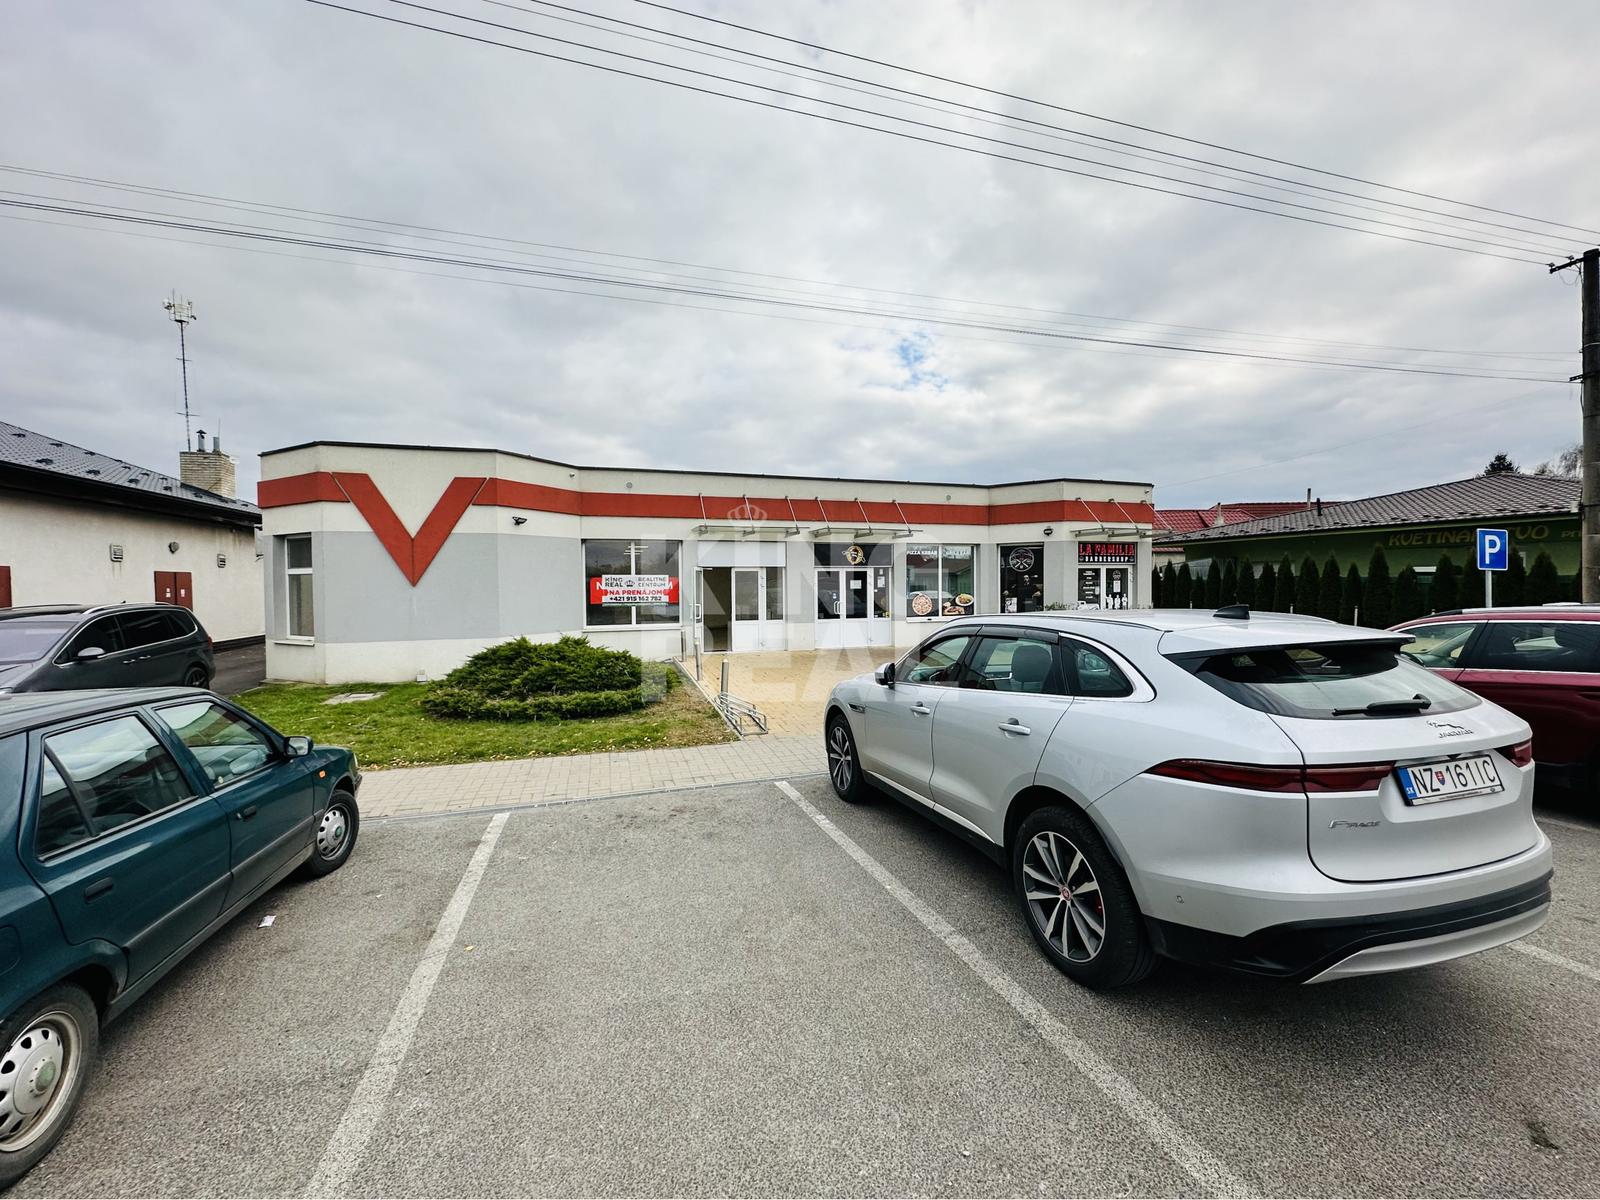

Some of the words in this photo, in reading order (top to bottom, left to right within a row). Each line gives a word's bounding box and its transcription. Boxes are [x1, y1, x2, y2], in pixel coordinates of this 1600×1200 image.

[1079, 544, 1092, 555] LA
[1094, 544, 1135, 555] FAMILIA
[1484, 535, 1501, 564] P
[1411, 768, 1440, 794] NZ
